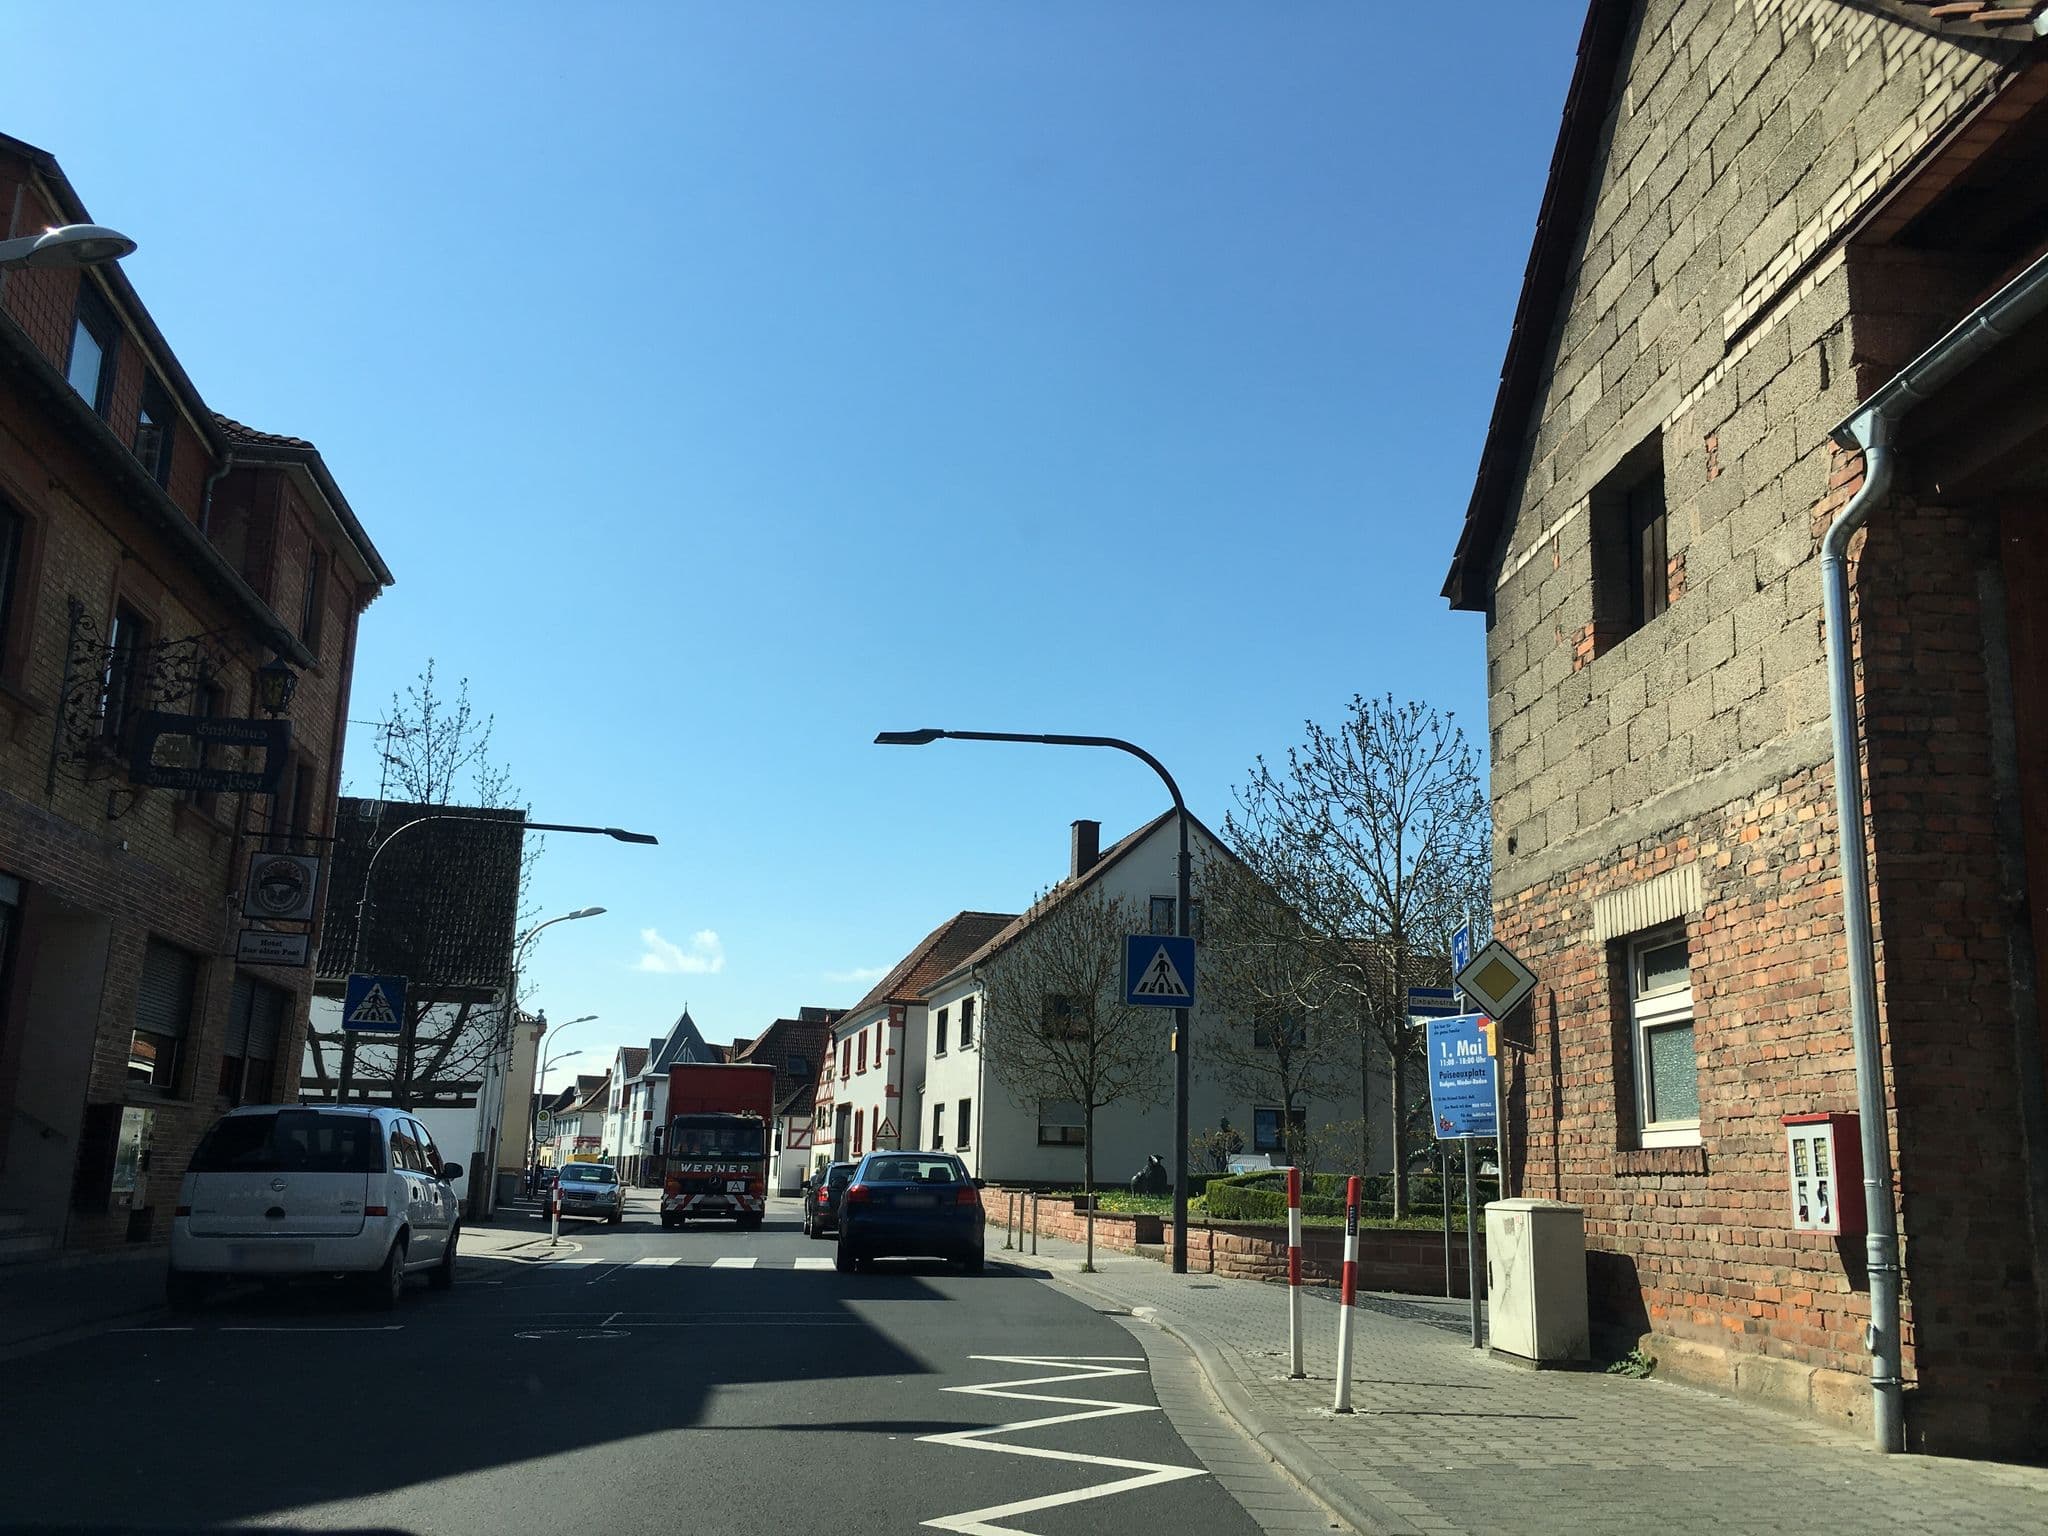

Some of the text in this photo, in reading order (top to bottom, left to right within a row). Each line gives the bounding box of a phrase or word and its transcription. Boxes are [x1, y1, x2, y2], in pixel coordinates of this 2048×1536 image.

[196, 722, 268, 738] Gasthaus
[224, 773, 263, 791] Post
[260, 939, 283, 947] Hotel
[281, 948, 300, 956] Post
[1441, 1038, 1482, 1058] 1. Mai
[681, 1163, 750, 1173] WERNER
[731, 1181, 741, 1190] A
